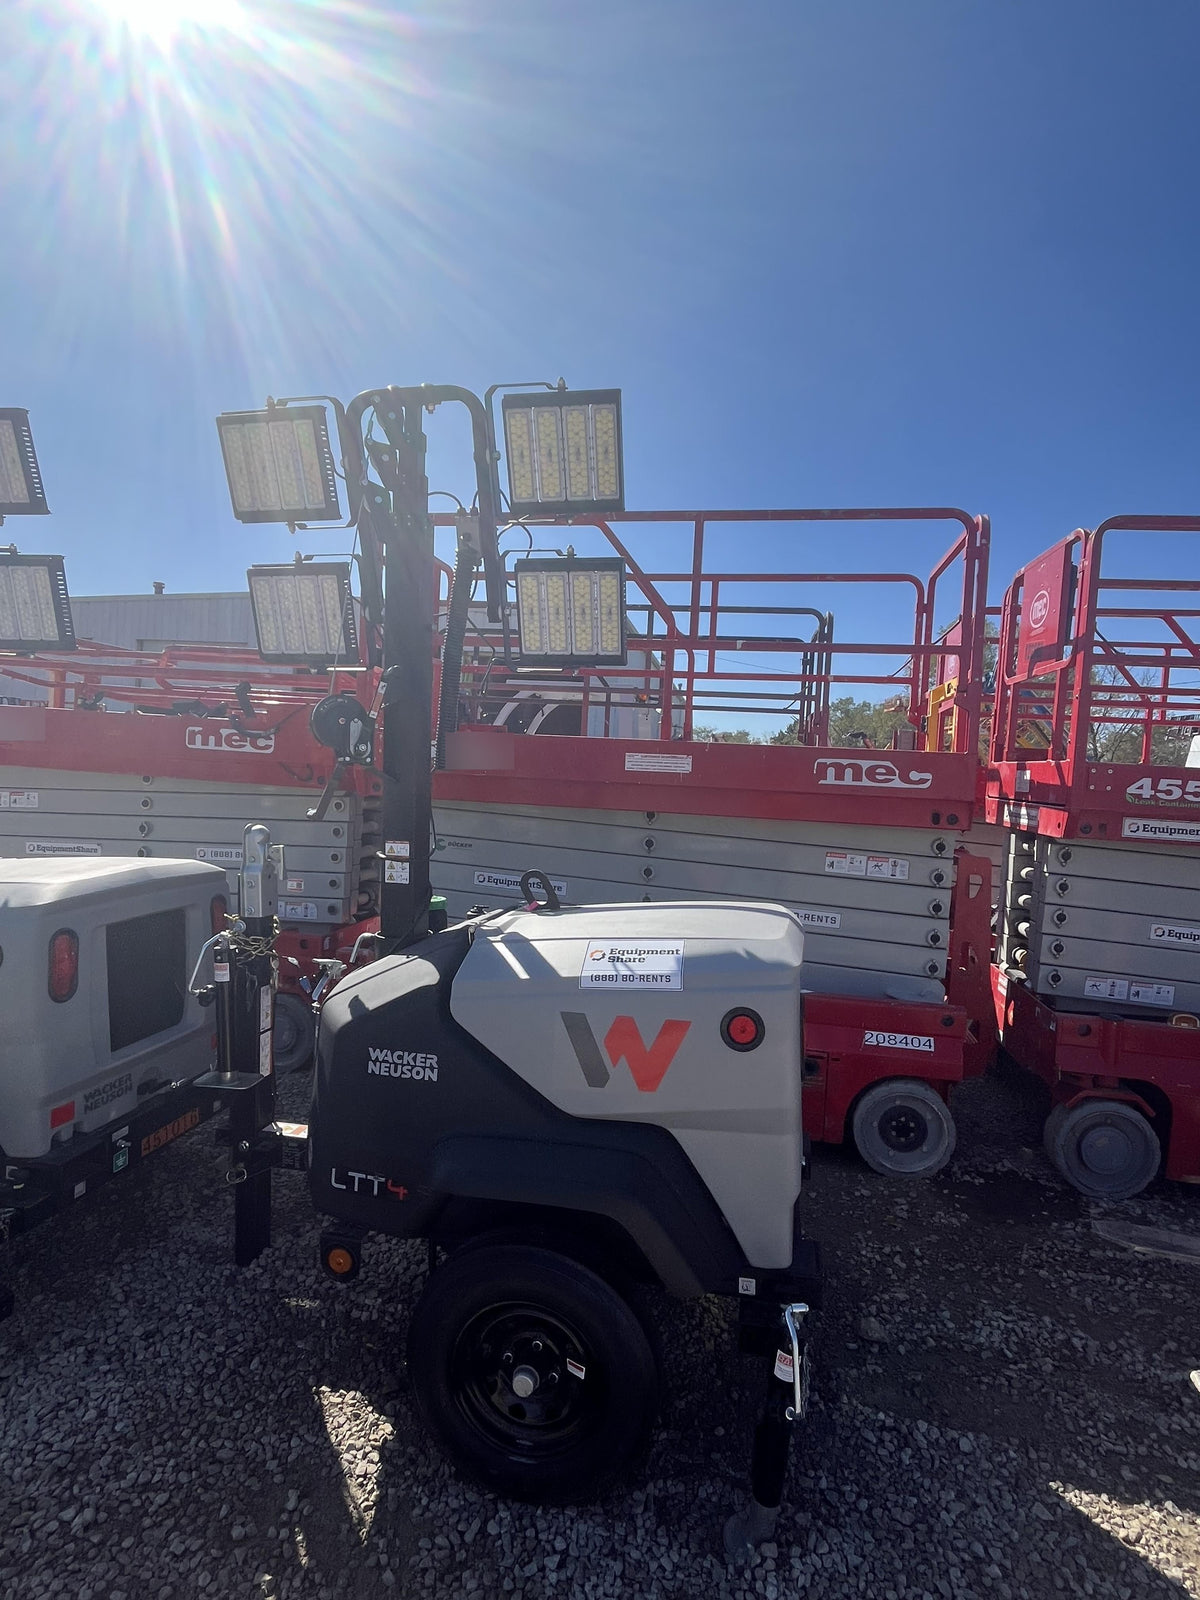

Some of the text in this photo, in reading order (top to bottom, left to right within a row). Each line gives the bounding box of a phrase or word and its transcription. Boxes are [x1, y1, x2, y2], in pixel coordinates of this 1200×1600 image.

[814, 759, 932, 788] mec
[609, 948, 680, 956] Equipment
[590, 974, 671, 983] (888) 80-RENTS
[865, 1032, 932, 1049] 208404
[368, 1047, 439, 1068] WACKER
[368, 1061, 439, 1082] NEUSON
[331, 1167, 408, 1200] LTT4
